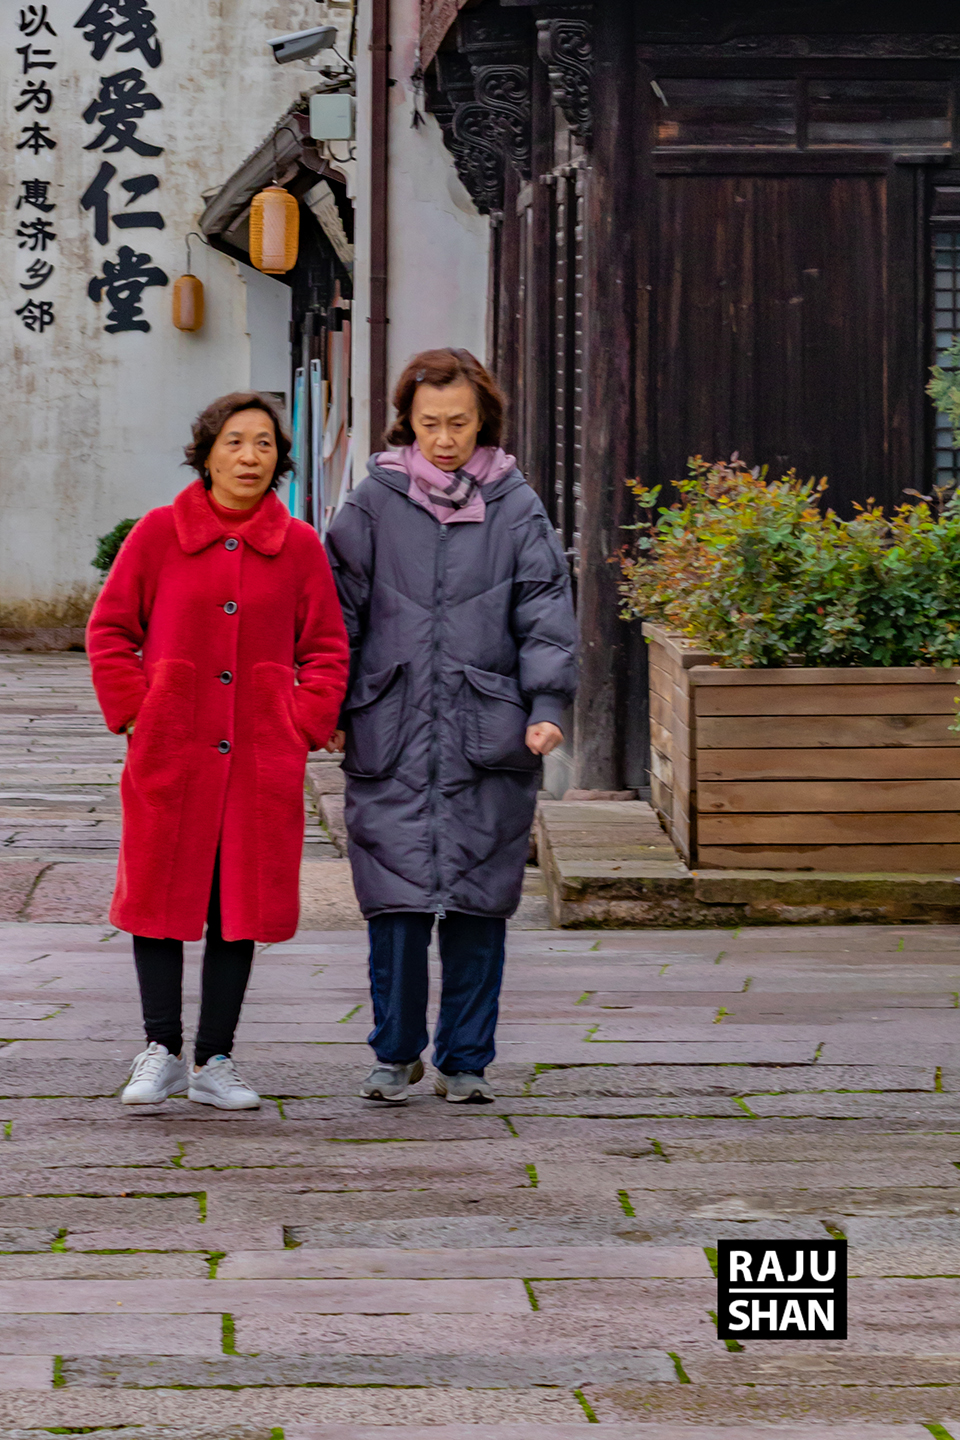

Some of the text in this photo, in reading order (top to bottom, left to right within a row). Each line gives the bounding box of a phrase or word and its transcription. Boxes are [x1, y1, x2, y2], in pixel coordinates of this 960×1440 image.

[14, 4, 58, 333] 以仁为本 惠济乡邻
